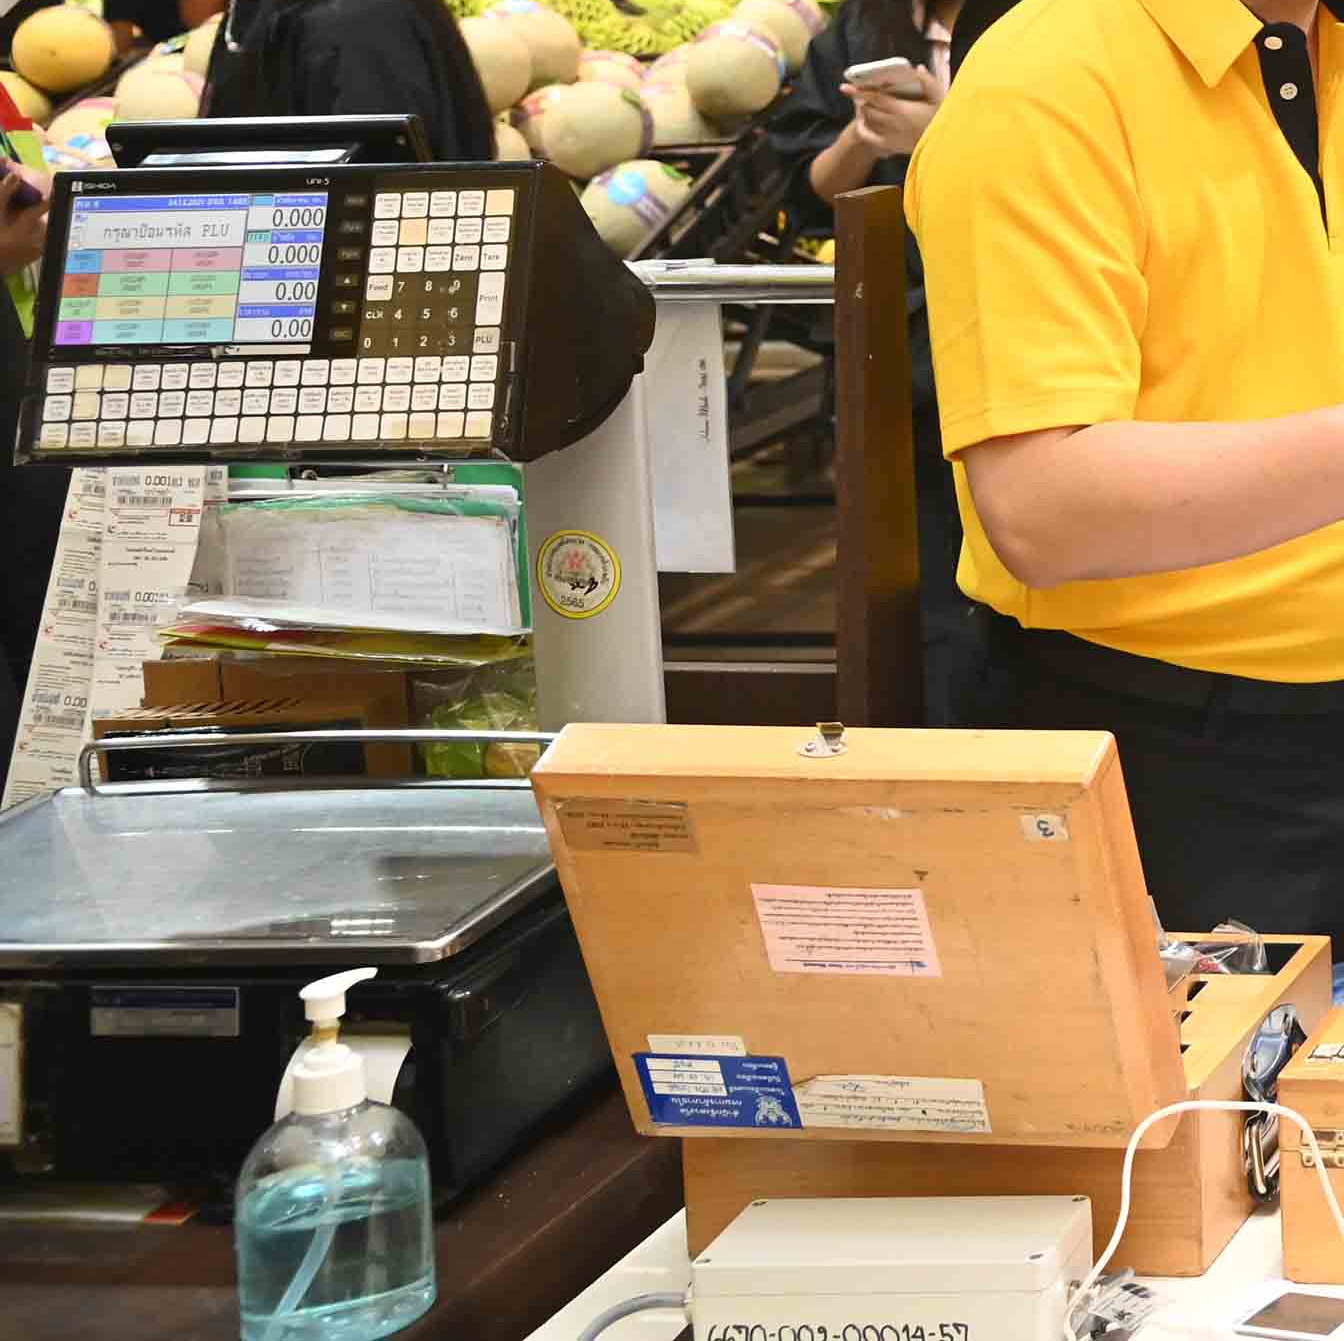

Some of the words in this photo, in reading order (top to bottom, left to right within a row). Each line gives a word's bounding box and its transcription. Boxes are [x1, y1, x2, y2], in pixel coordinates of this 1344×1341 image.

[272, 208, 324, 228] 0.000
[200, 224, 230, 238] PLU
[268, 244, 320, 264] 0.000
[275, 282, 316, 301] 0.00
[271, 319, 312, 339] 0.00
